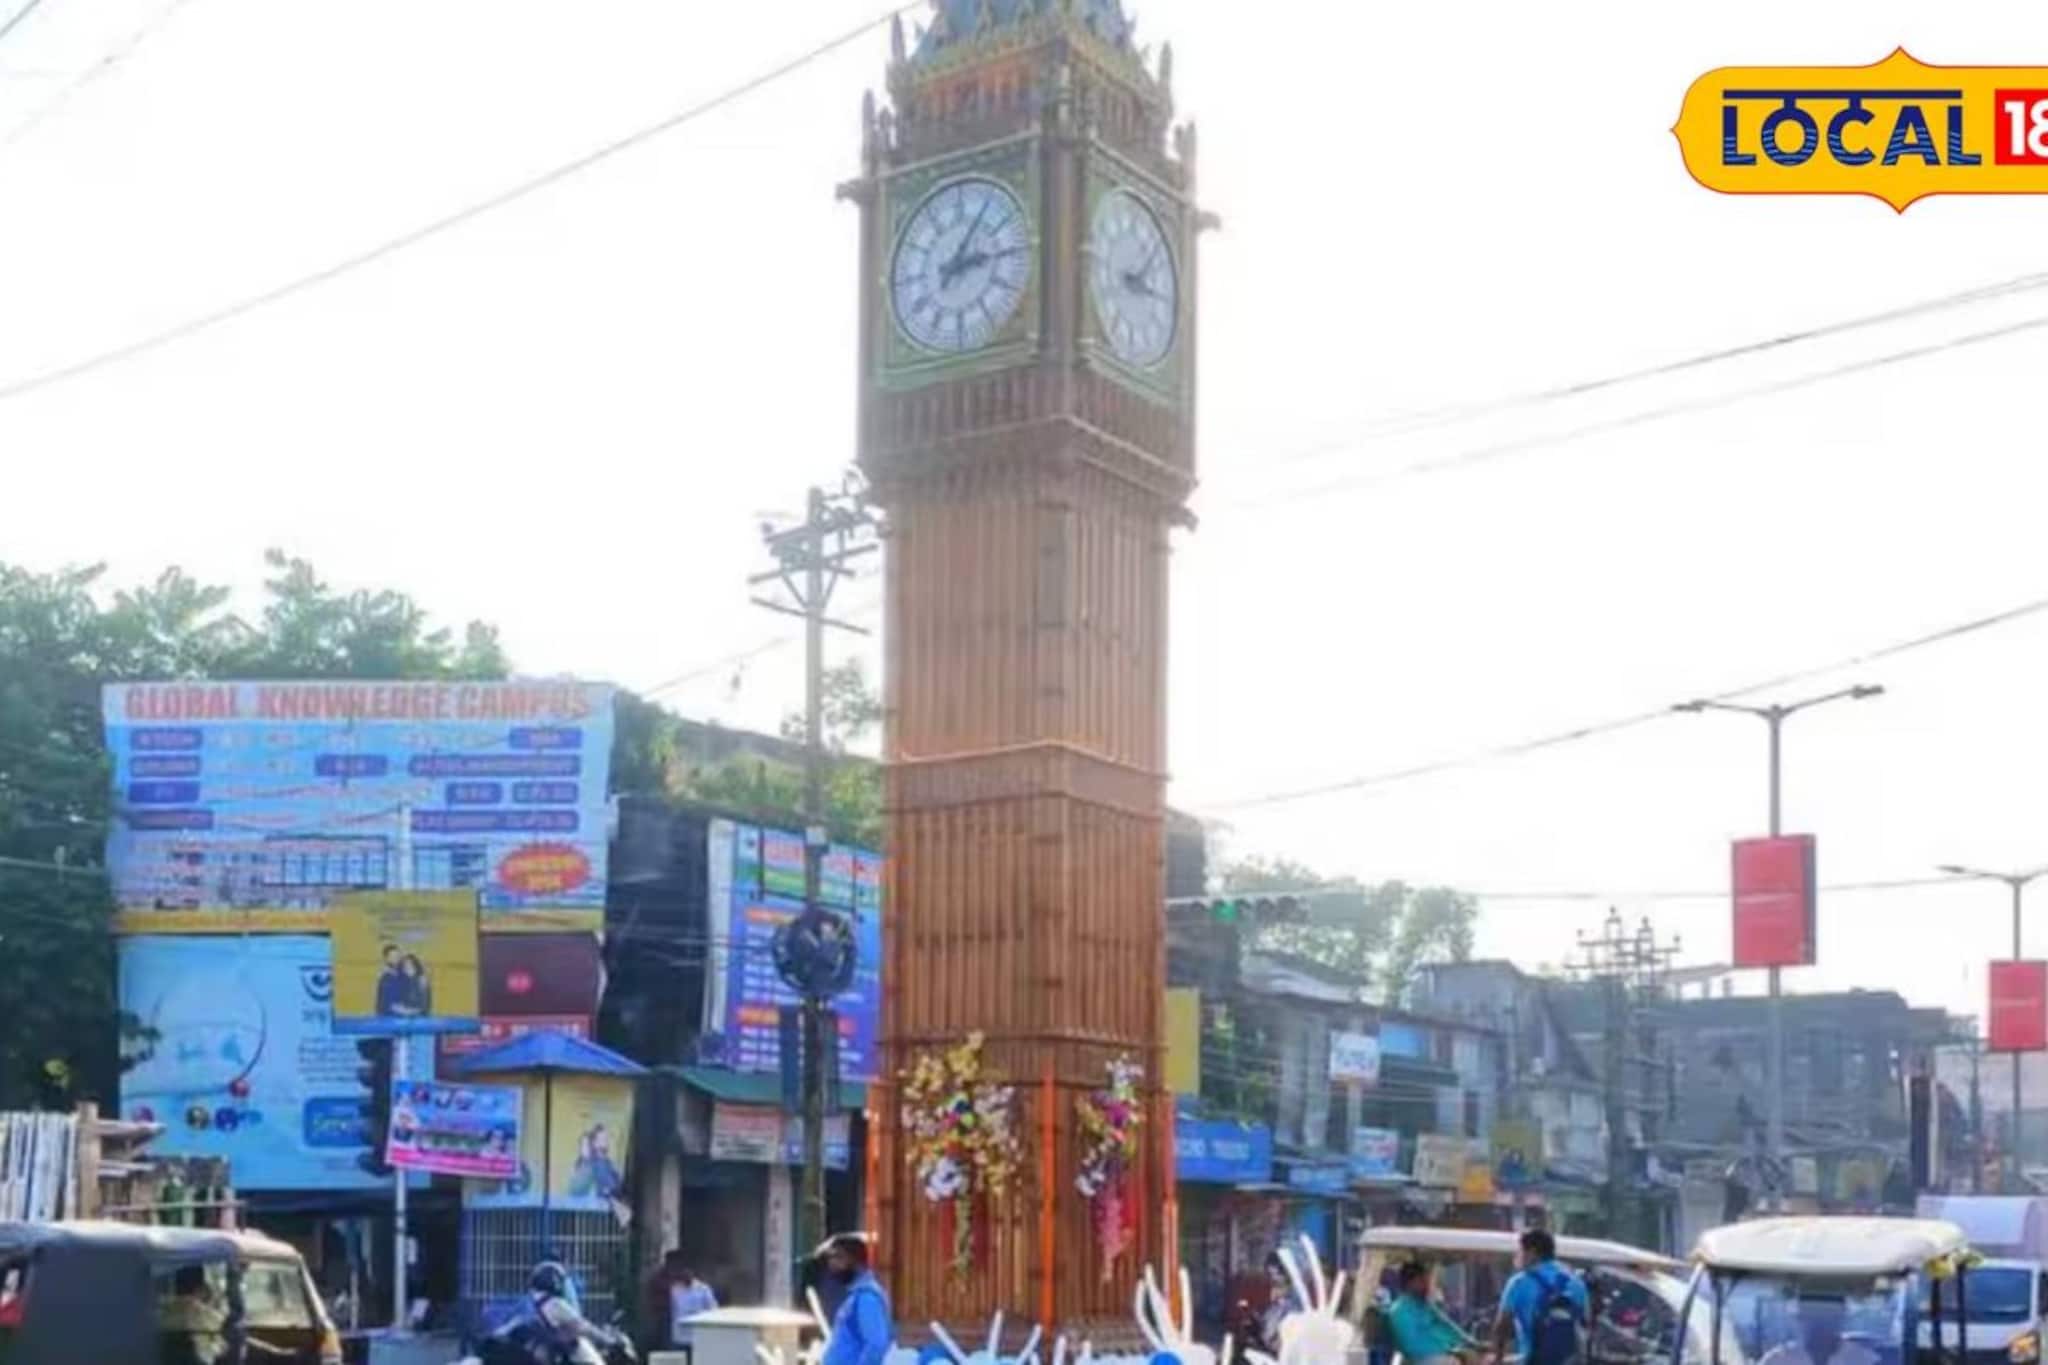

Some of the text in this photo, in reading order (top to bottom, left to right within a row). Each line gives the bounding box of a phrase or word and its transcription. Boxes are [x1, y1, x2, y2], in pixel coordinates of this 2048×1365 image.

[127, 682, 591, 720] GLOBAL KNOWLEDGE CAMPUS
